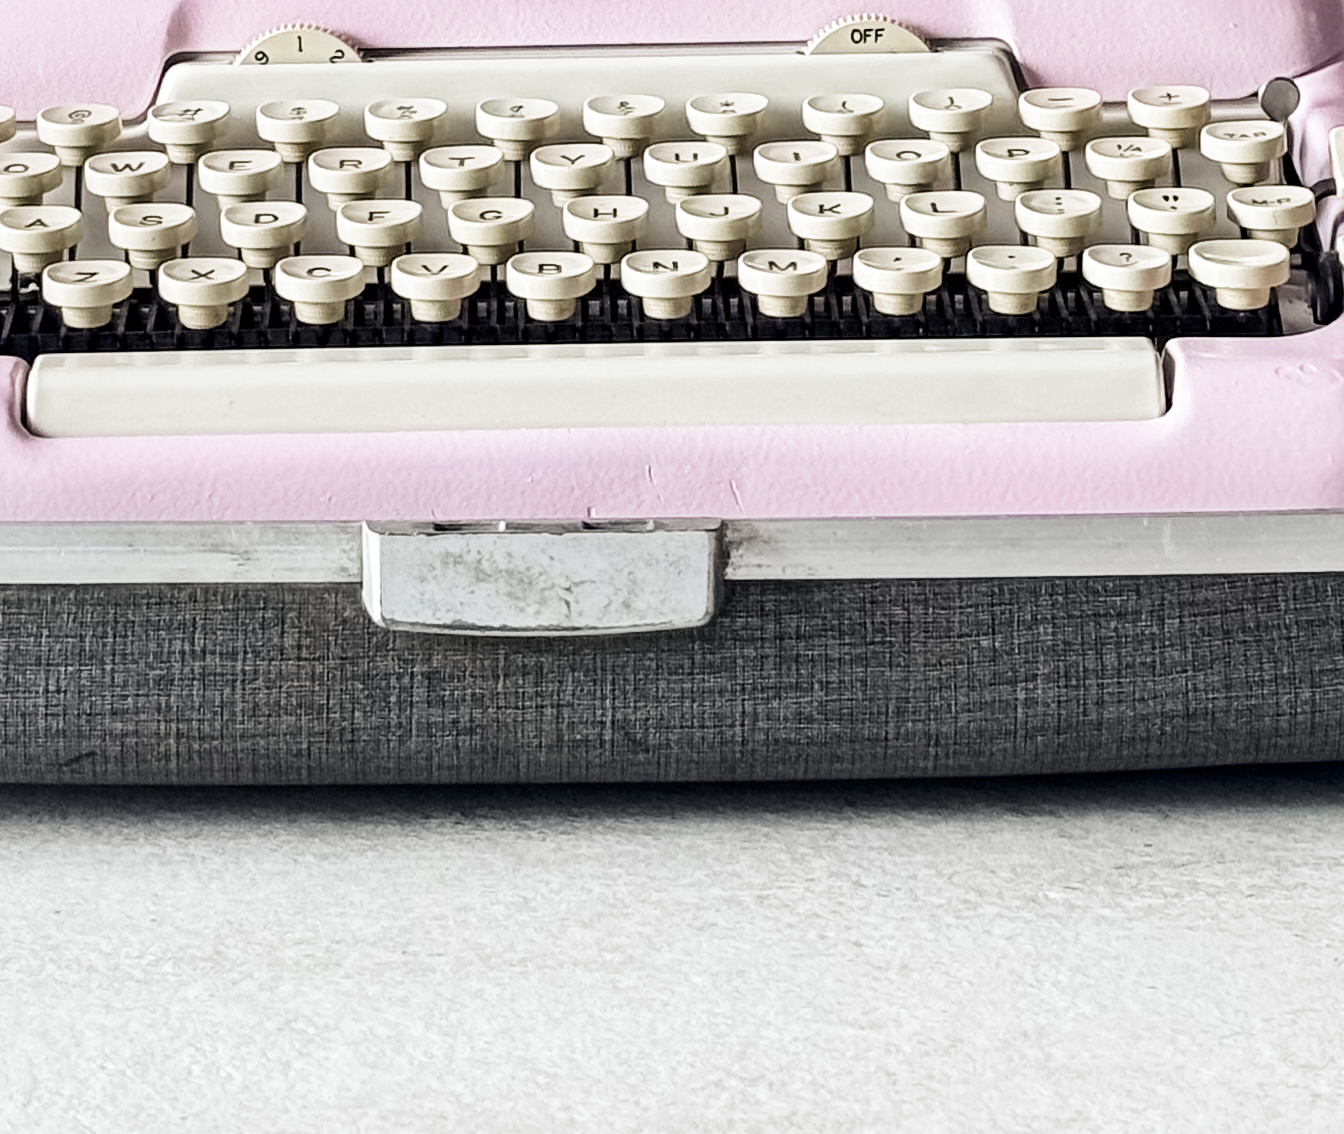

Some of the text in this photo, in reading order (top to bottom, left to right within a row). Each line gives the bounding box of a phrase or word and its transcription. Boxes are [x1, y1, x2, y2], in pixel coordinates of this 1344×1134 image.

[297, 35, 304, 53] 1
[850, 28, 886, 44] OFF
[110, 162, 146, 173] W
[229, 160, 253, 171] E
[339, 159, 363, 169] R
[448, 156, 476, 168] T
[560, 154, 586, 168] Y
[895, 150, 922, 161] O
[24, 218, 50, 229] A
[139, 214, 164, 226] S
[253, 213, 279, 224] D
[367, 210, 392, 222] F
[479, 209, 504, 221] G
[593, 207, 618, 219] H
[709, 206, 730, 217] J
[818, 203, 842, 215] K
[930, 202, 959, 213] L
[72, 271, 101, 284] Z
[191, 268, 216, 280] X
[306, 266, 332, 278] C
[420, 264, 450, 276] V
[537, 263, 563, 274] B
[652, 261, 679, 273] N
[767, 260, 798, 272] M
